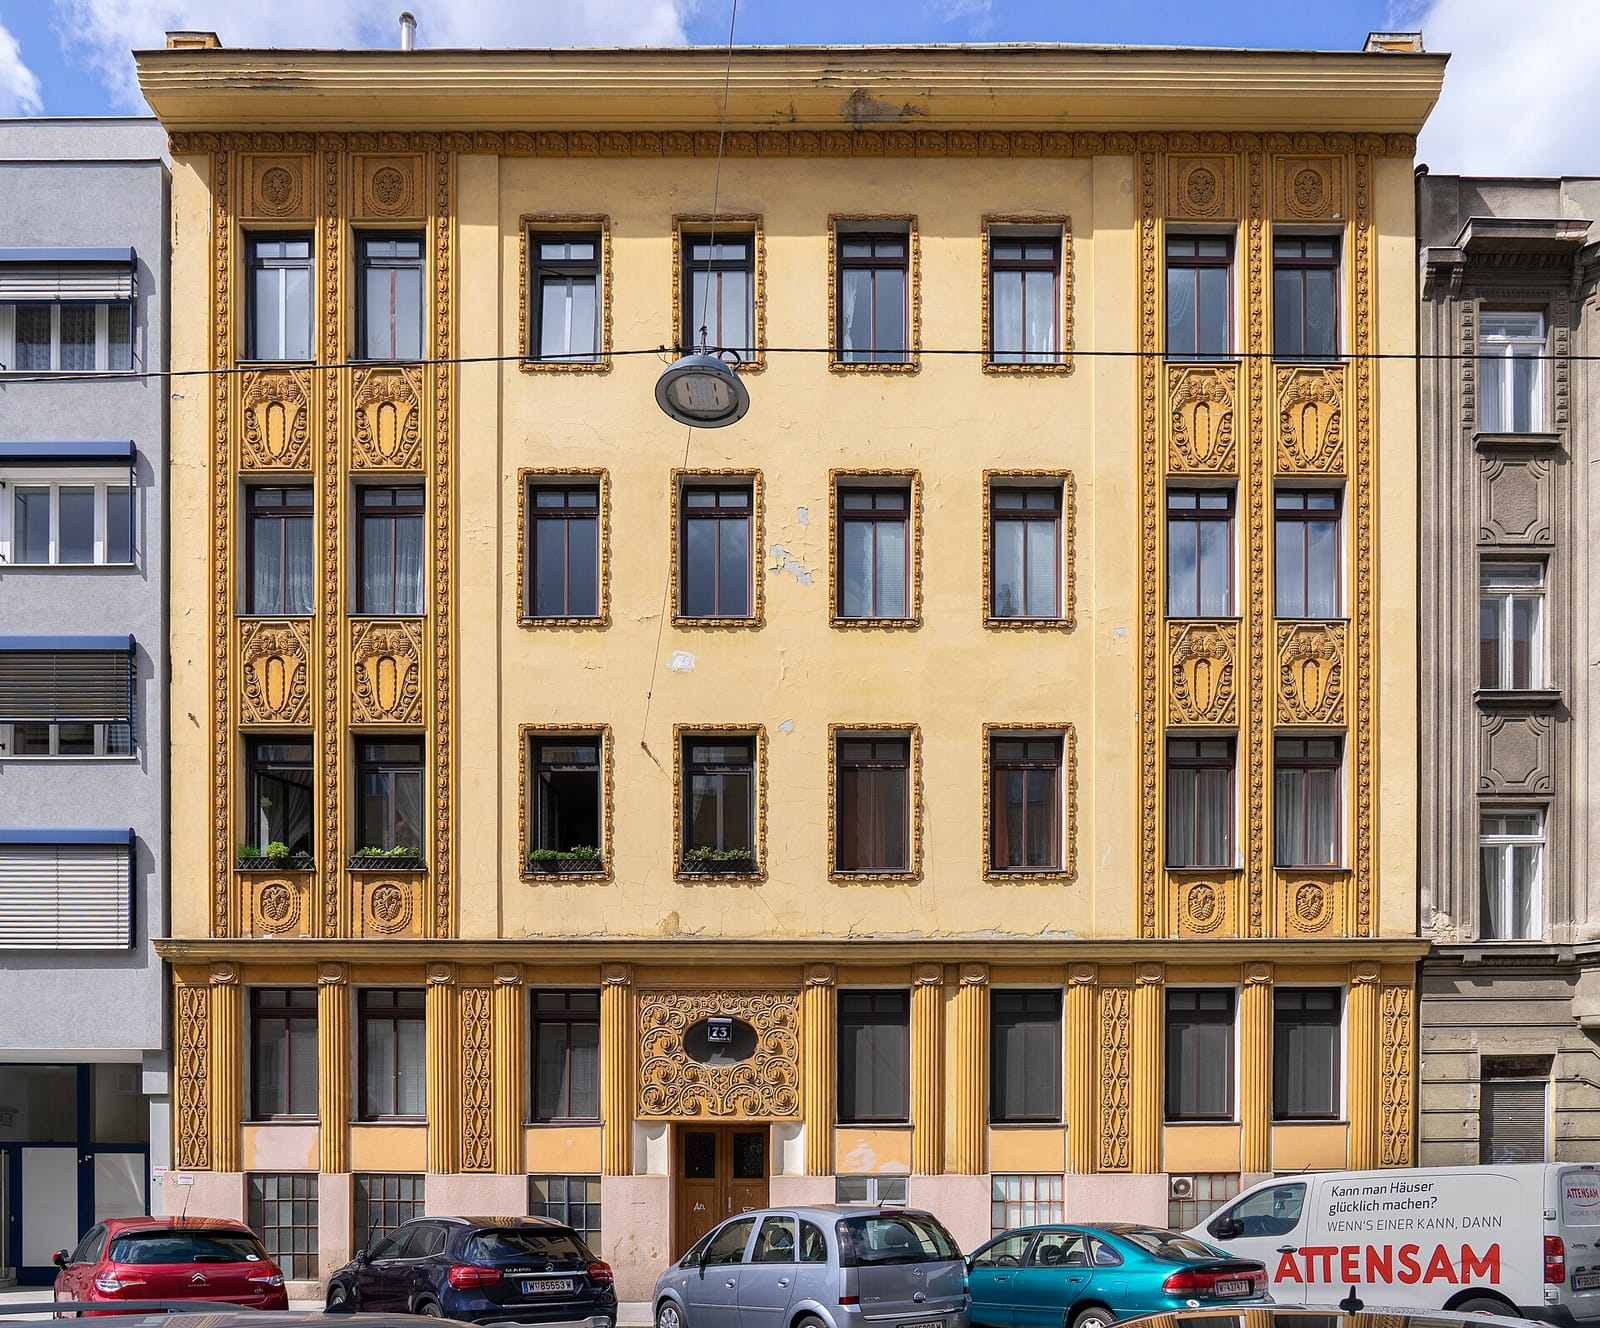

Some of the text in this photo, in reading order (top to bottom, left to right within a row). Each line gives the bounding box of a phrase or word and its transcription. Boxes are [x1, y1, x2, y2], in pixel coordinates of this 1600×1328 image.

[711, 1026, 728, 1037] 73
[1331, 1182, 1434, 1197] Kann man Häuser
[1566, 1187, 1600, 1199] ATTENSAM
[1328, 1196, 1438, 1216] glücklich machen?
[1327, 1216, 1502, 1232] WENN'S EINER KANN, DANN
[1273, 1243, 1500, 1285] ATTENSAM
[528, 1282, 535, 1291] W
[540, 1281, 565, 1291] 85553
